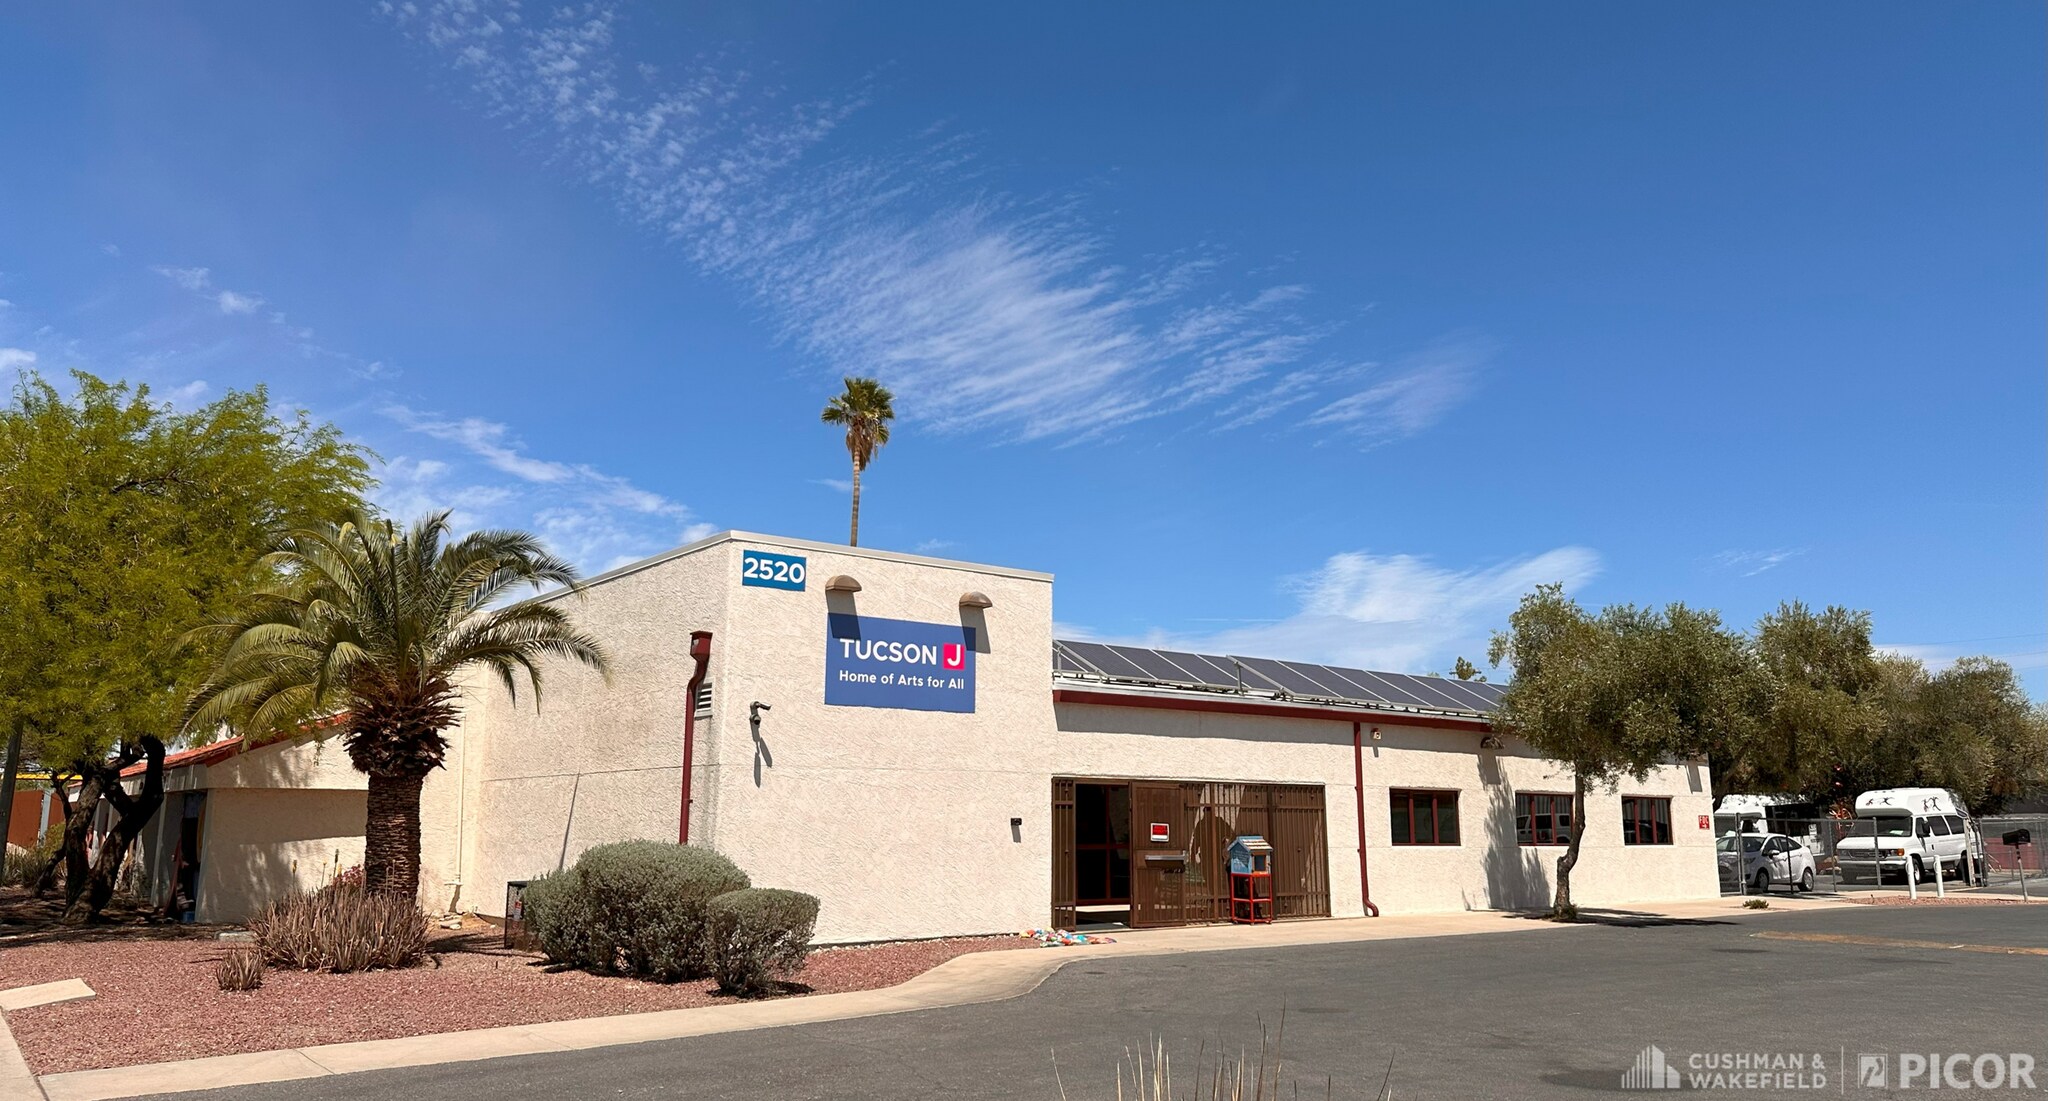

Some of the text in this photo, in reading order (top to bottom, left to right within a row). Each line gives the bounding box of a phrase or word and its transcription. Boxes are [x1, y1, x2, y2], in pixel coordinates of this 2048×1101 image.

[743, 557, 804, 584] 2520
[839, 638, 961, 666] TUCSON J
[839, 669, 964, 690] Home of Arts for All
